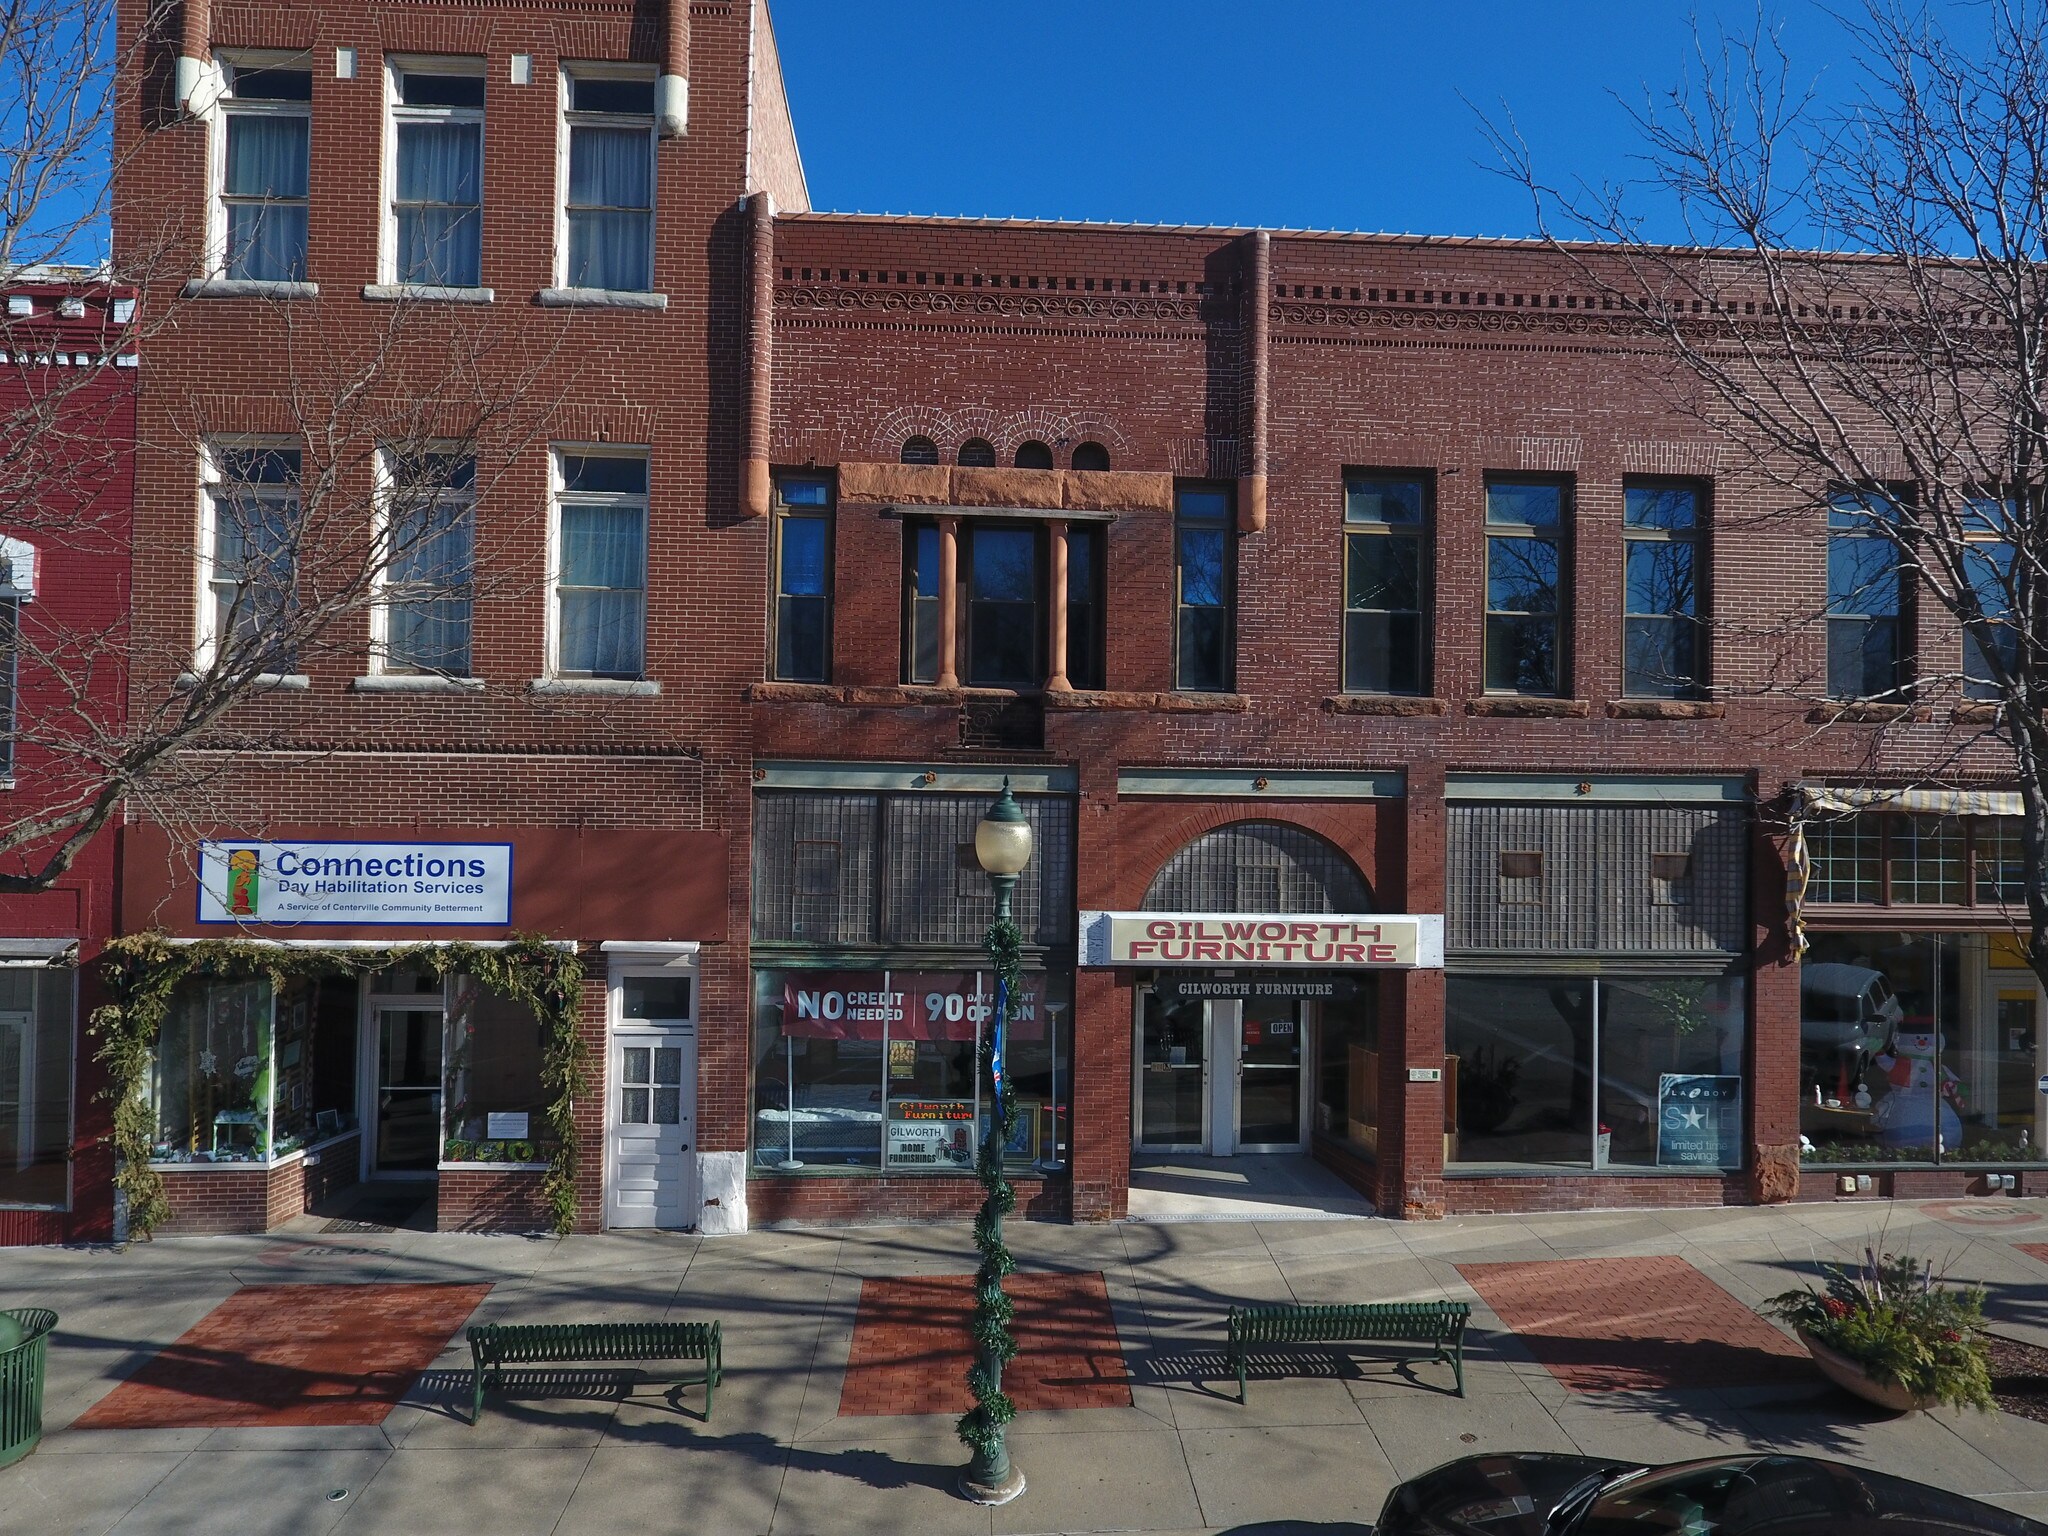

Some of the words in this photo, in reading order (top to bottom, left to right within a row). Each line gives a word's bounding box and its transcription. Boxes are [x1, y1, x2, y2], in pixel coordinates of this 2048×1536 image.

[276, 851, 486, 877] Connections
[278, 880, 309, 895] Day
[315, 881, 408, 893] Habilitation
[413, 881, 483, 894] Services
[382, 904, 432, 913] Community
[1146, 921, 1381, 942] GILWORTH
[1129, 942, 1396, 962] FURNITURE
[1178, 983, 1250, 995] GILWORTH
[1256, 984, 1333, 995] FURNITURE
[847, 992, 904, 1005] CREDIT
[797, 991, 844, 1019] NO
[925, 993, 964, 1021] 90
[847, 1008, 903, 1020] NEEDED
[1273, 1024, 1292, 1032] OPEN
[890, 1128, 941, 1136] GILWORTH
[900, 1144, 925, 1153] HOME
[1672, 1141, 1703, 1150] limited
[1706, 1141, 1728, 1150] time
[889, 1154, 936, 1163] FURNISHINGS
[1681, 1152, 1719, 1162] savings
